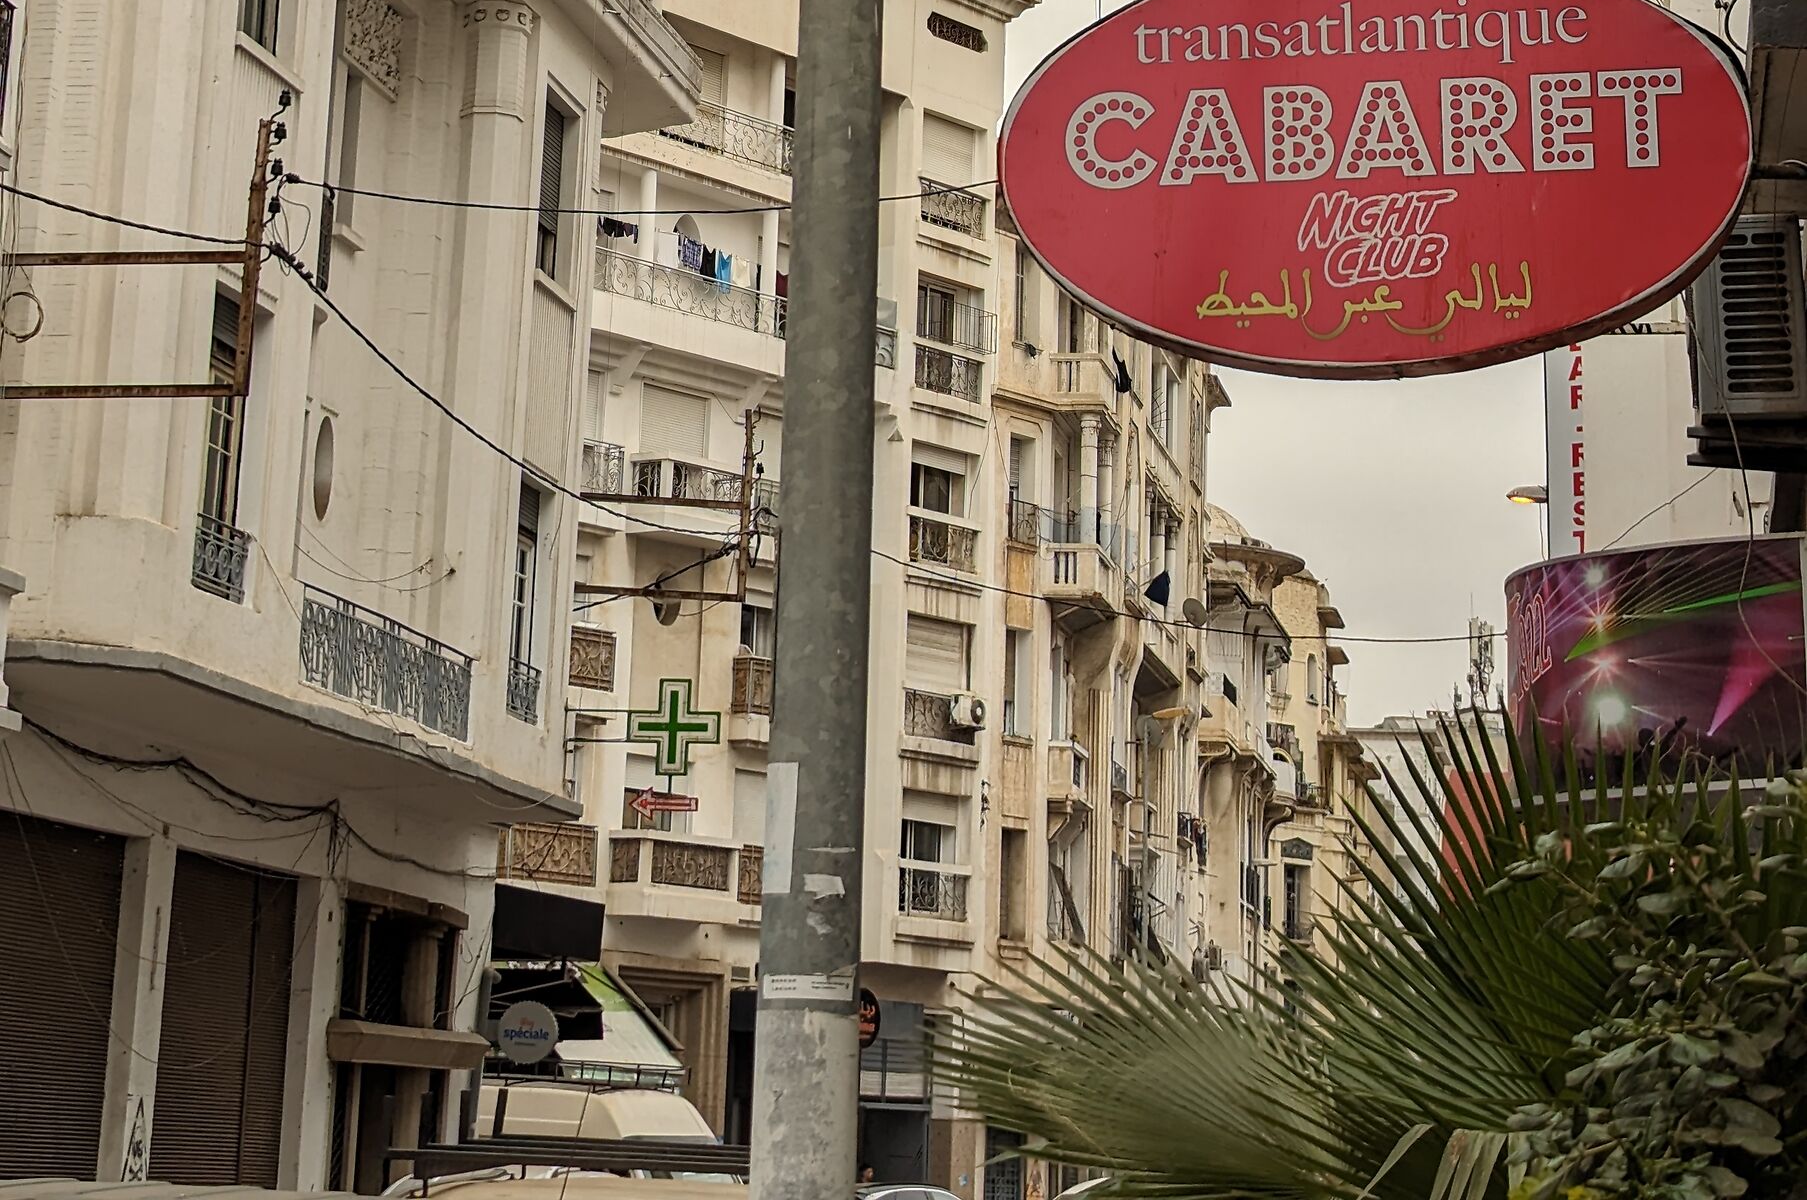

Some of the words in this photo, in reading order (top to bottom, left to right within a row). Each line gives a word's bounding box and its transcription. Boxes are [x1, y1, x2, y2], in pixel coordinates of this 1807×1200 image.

[1064, 67, 1683, 189] CABARET
[1297, 189, 1458, 251] NIGHT
[1324, 233, 1449, 287] CLUB
[1196, 268, 1312, 328] المحيط
[1301, 285, 1403, 340] عبر
[1385, 261, 1533, 342] ليالي
[1568, 343, 1584, 410] AR
